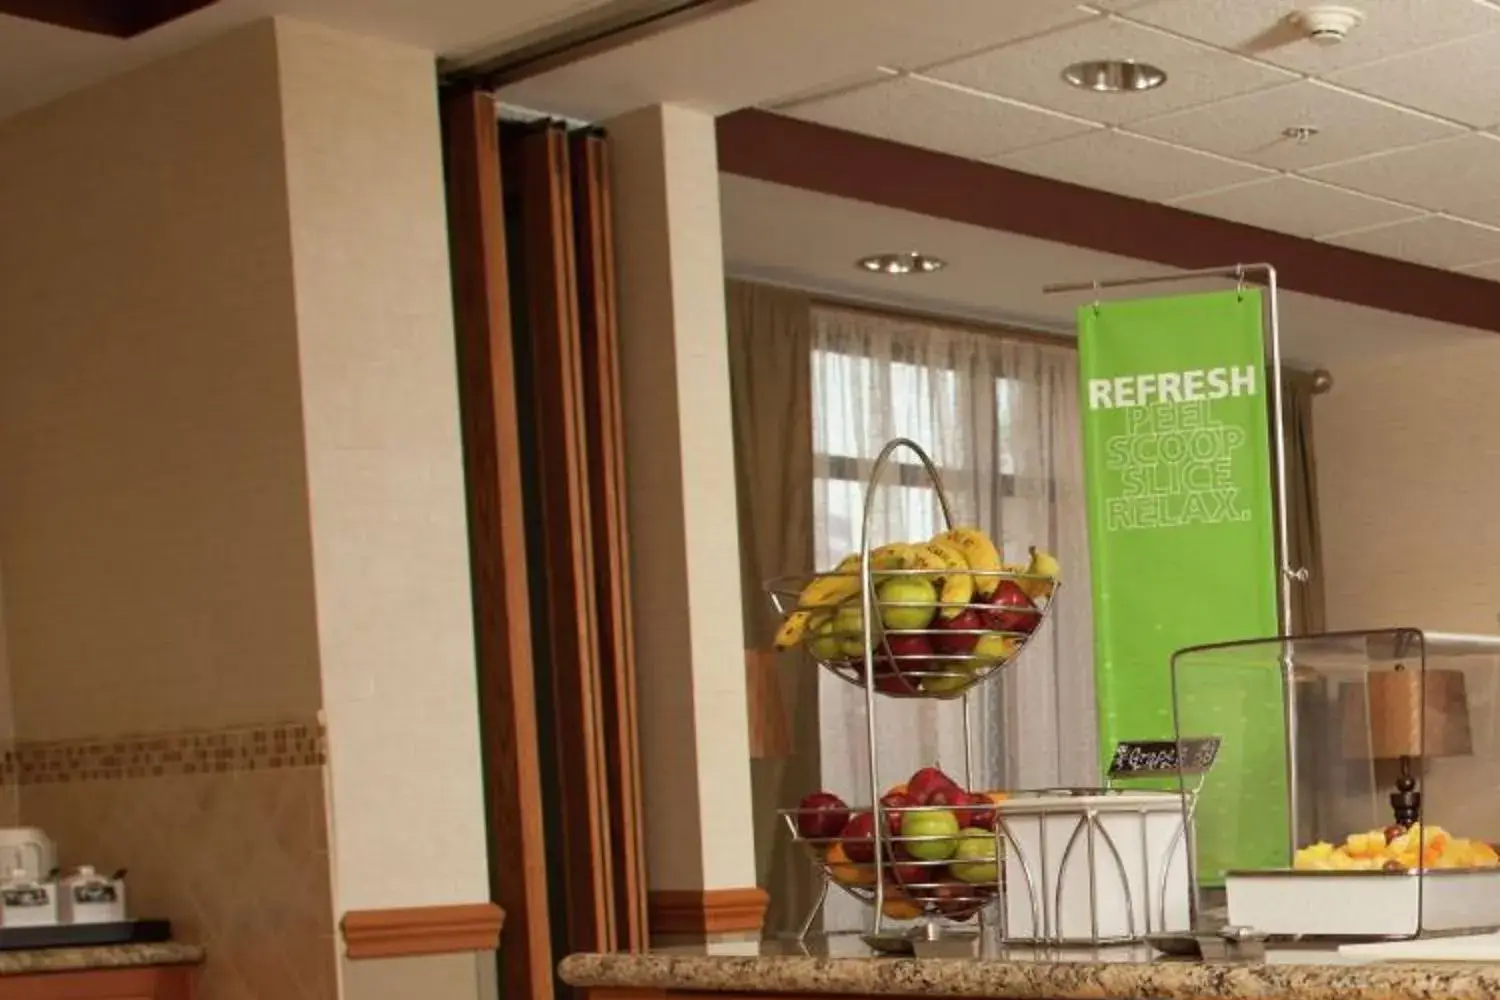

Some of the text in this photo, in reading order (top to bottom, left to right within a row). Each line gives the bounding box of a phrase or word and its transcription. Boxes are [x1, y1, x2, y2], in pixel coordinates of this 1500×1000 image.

[1088, 365, 1257, 410] REFRESH
[1126, 397, 1222, 435] PEEL
[1107, 425, 1244, 470] SCOOP
[1122, 457, 1233, 498] SLICE
[1107, 488, 1251, 531] RELAX.
